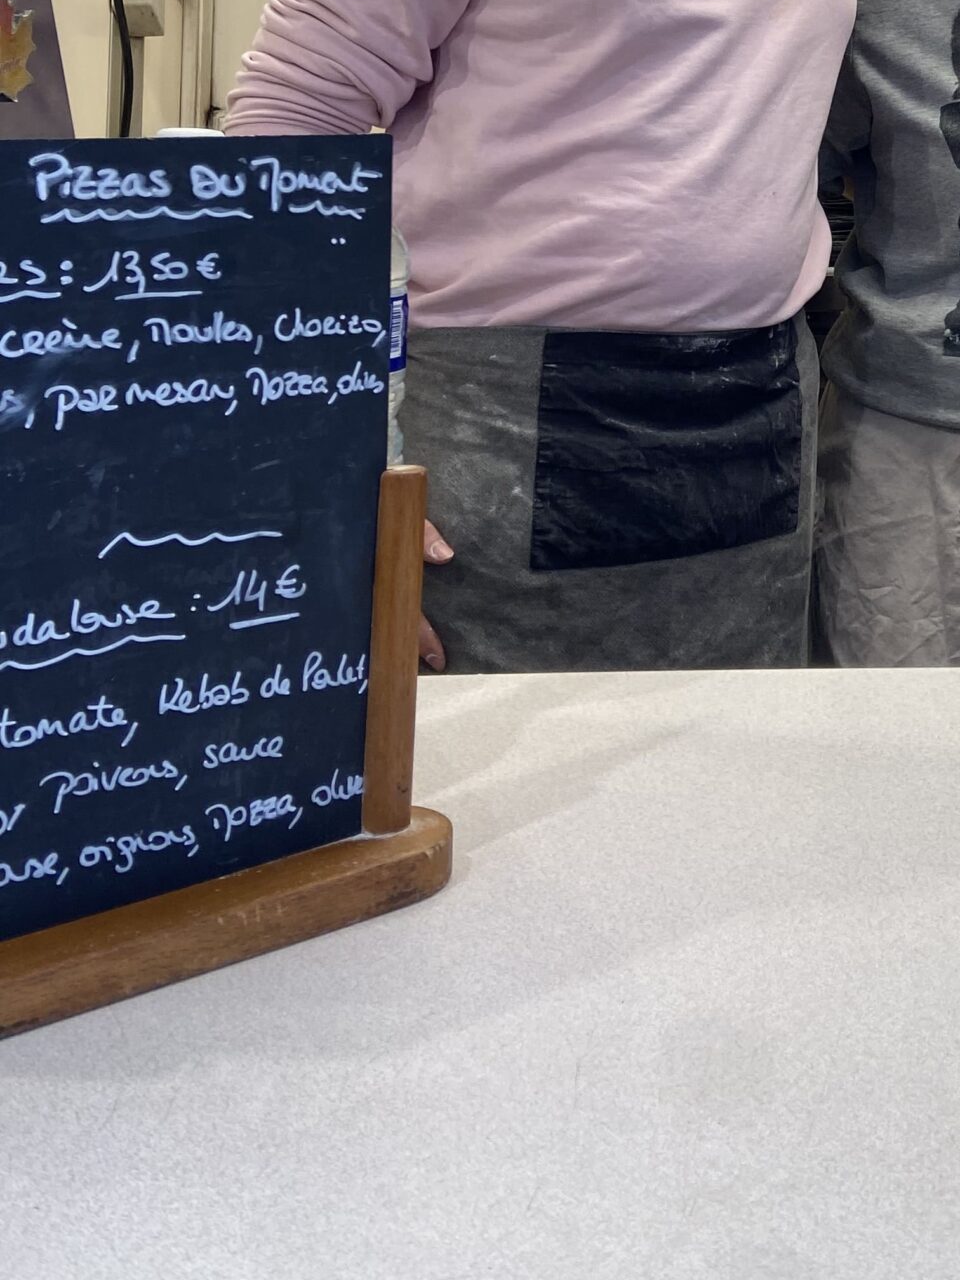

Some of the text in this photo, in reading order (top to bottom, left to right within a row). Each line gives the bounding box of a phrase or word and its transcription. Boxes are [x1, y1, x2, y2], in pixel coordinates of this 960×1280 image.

[29, 152, 172, 202] Pizzas
[159, 671, 250, 715] Kebab
[259, 663, 292, 699] de
[203, 735, 284, 769] sauce
